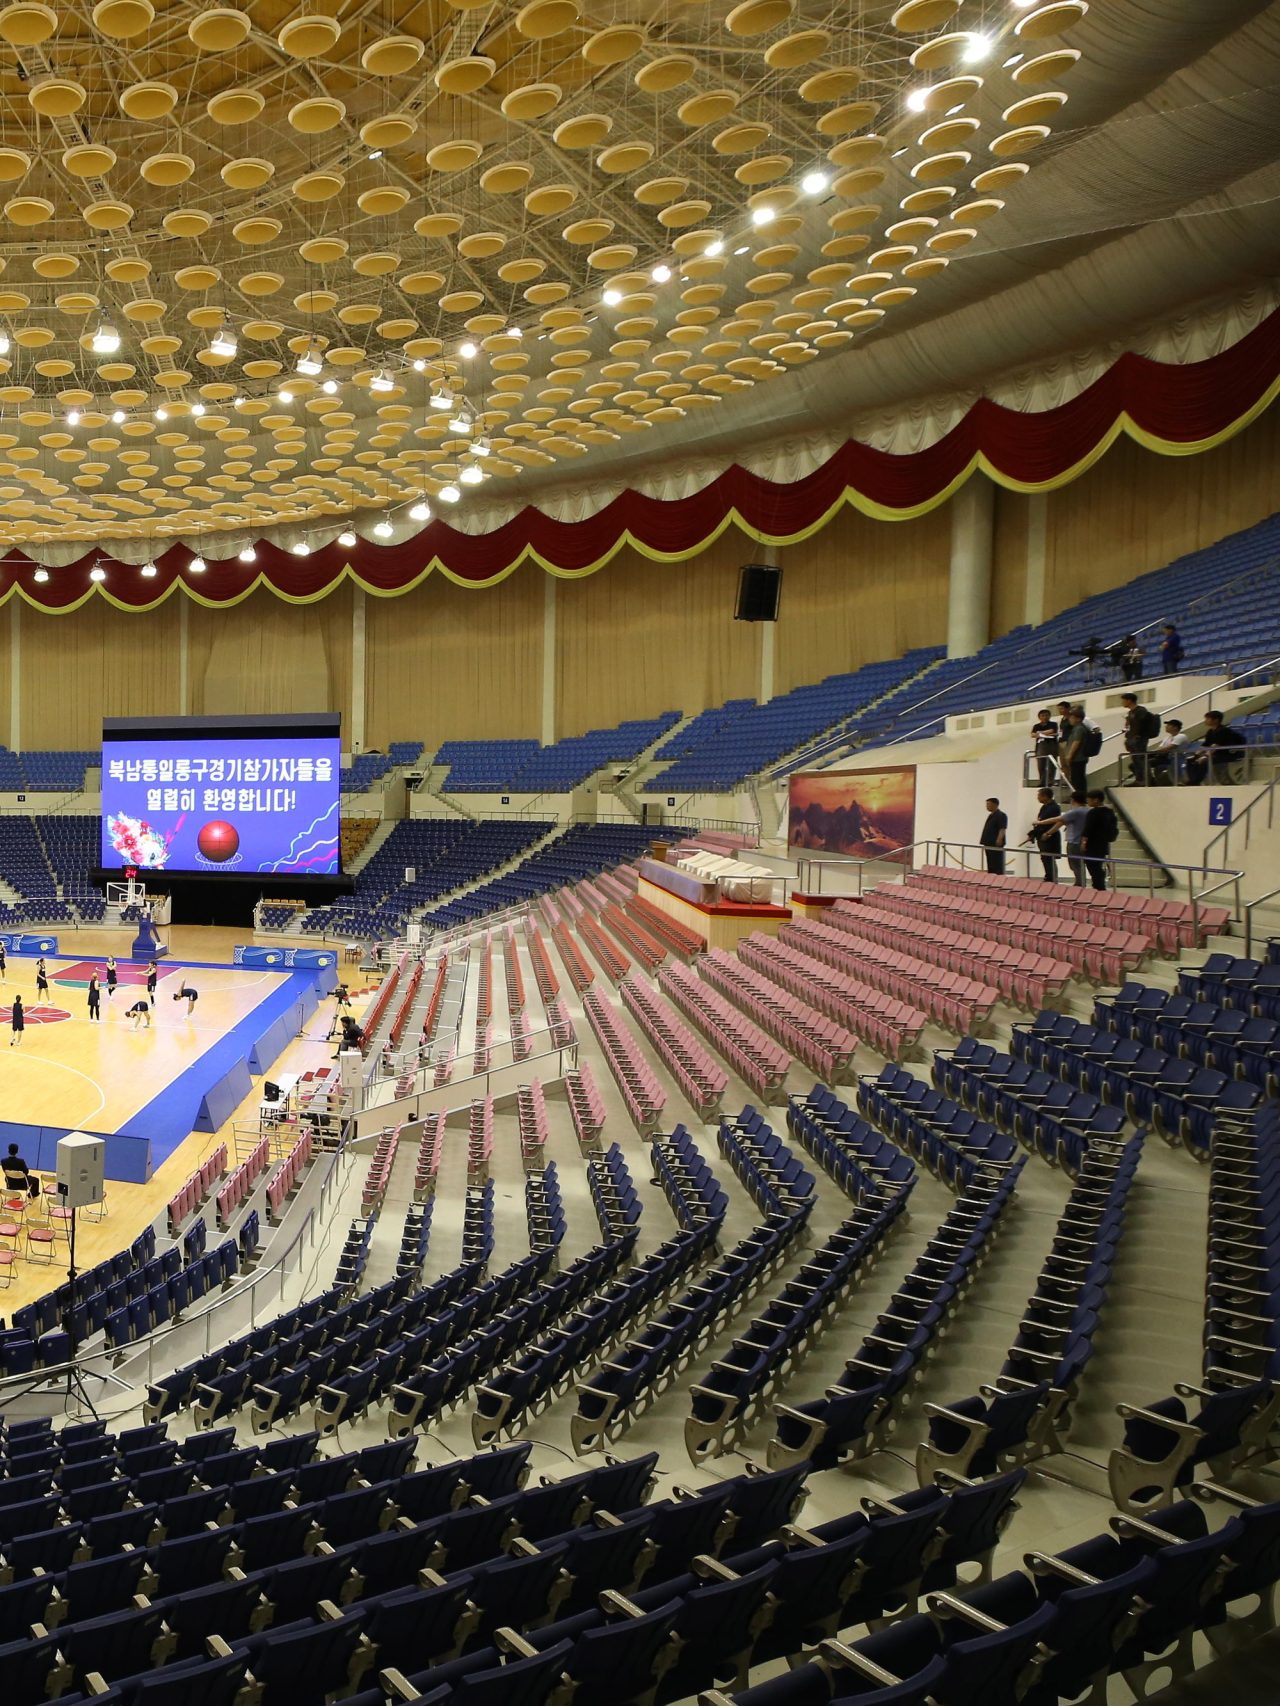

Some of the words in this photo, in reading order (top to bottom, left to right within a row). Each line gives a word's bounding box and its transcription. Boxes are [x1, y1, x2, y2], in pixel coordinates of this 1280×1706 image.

[108, 758, 333, 782] 북남통일롱구경기참가자들을
[147, 788, 195, 812] 열렬히
[203, 788, 296, 812] 환영합니다!
[1215, 803, 1224, 820] 2
[125, 870, 137, 878] 24
